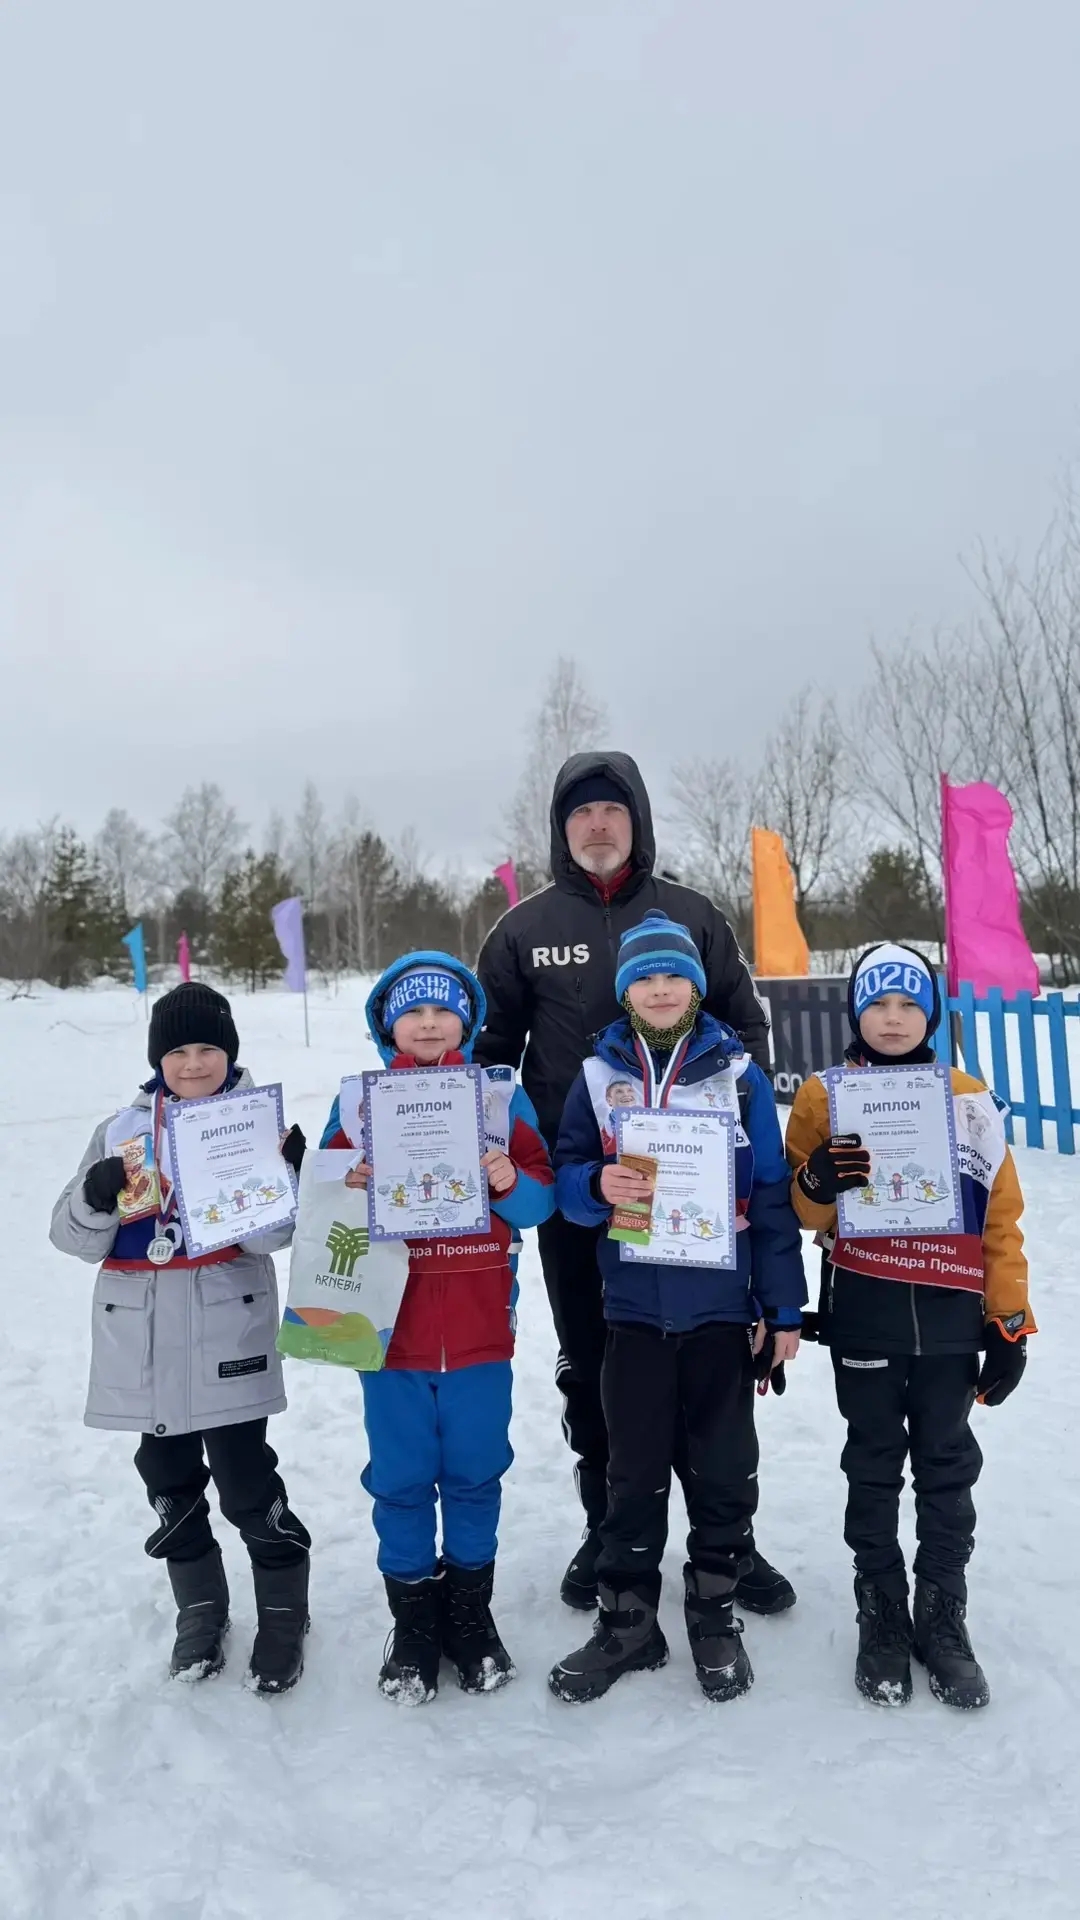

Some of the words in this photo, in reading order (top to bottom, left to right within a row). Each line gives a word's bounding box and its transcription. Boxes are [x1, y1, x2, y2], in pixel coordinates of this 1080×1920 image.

[532, 943, 590, 968] RUS
[854, 964, 921, 1008] 2026
[389, 986, 449, 1015] РОССИИ
[396, 1101, 452, 1115] ДИПЛОМ
[862, 1100, 920, 1114] ДИПЛОМ
[200, 1120, 255, 1141] ДИПЛОМ
[647, 1142, 703, 1154] ДИПЛОМ
[409, 1247, 432, 1259] дра
[436, 1242, 500, 1258] Пронькова
[842, 1242, 926, 1269] Александра
[890, 1238, 908, 1249] на
[912, 1240, 957, 1255] призы
[314, 1273, 362, 1293] ARNEBIA
